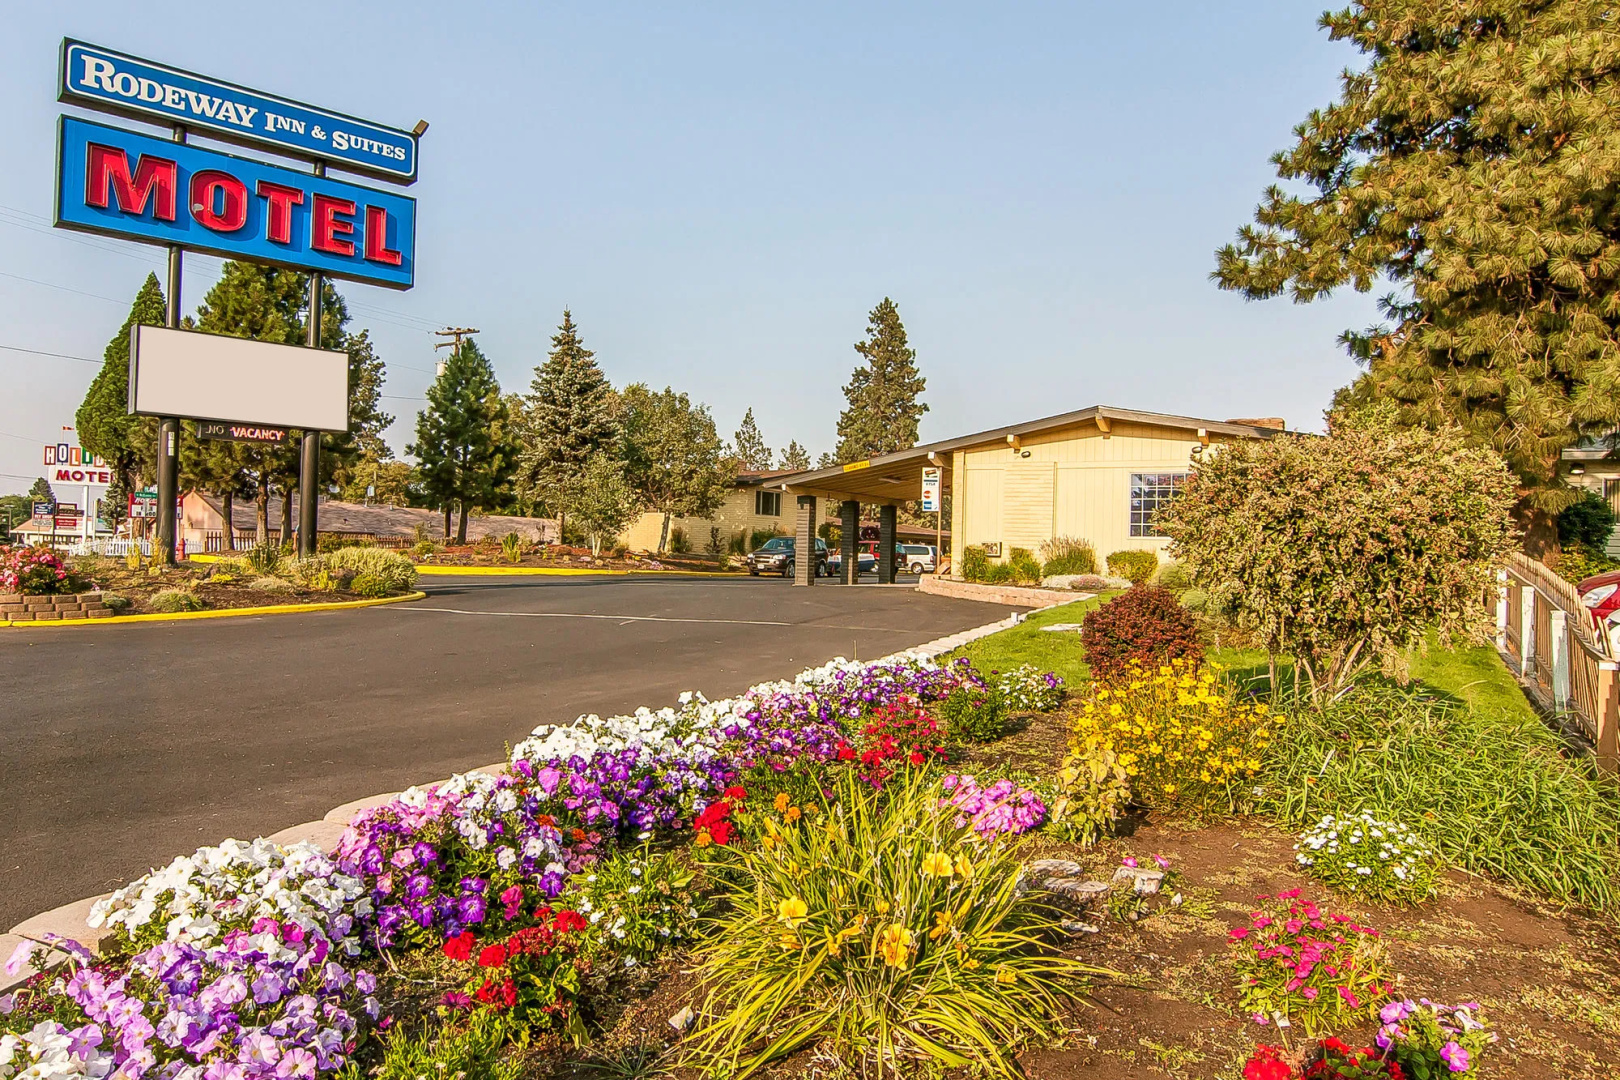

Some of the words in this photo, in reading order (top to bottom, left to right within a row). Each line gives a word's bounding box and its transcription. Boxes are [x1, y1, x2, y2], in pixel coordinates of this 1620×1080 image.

[80, 54, 258, 128] RODEWAY
[265, 112, 305, 136] INN
[311, 125, 327, 141] &
[332, 131, 406, 161] SUITES
[84, 141, 402, 266] MOTEL
[230, 426, 285, 441] VACANCY
